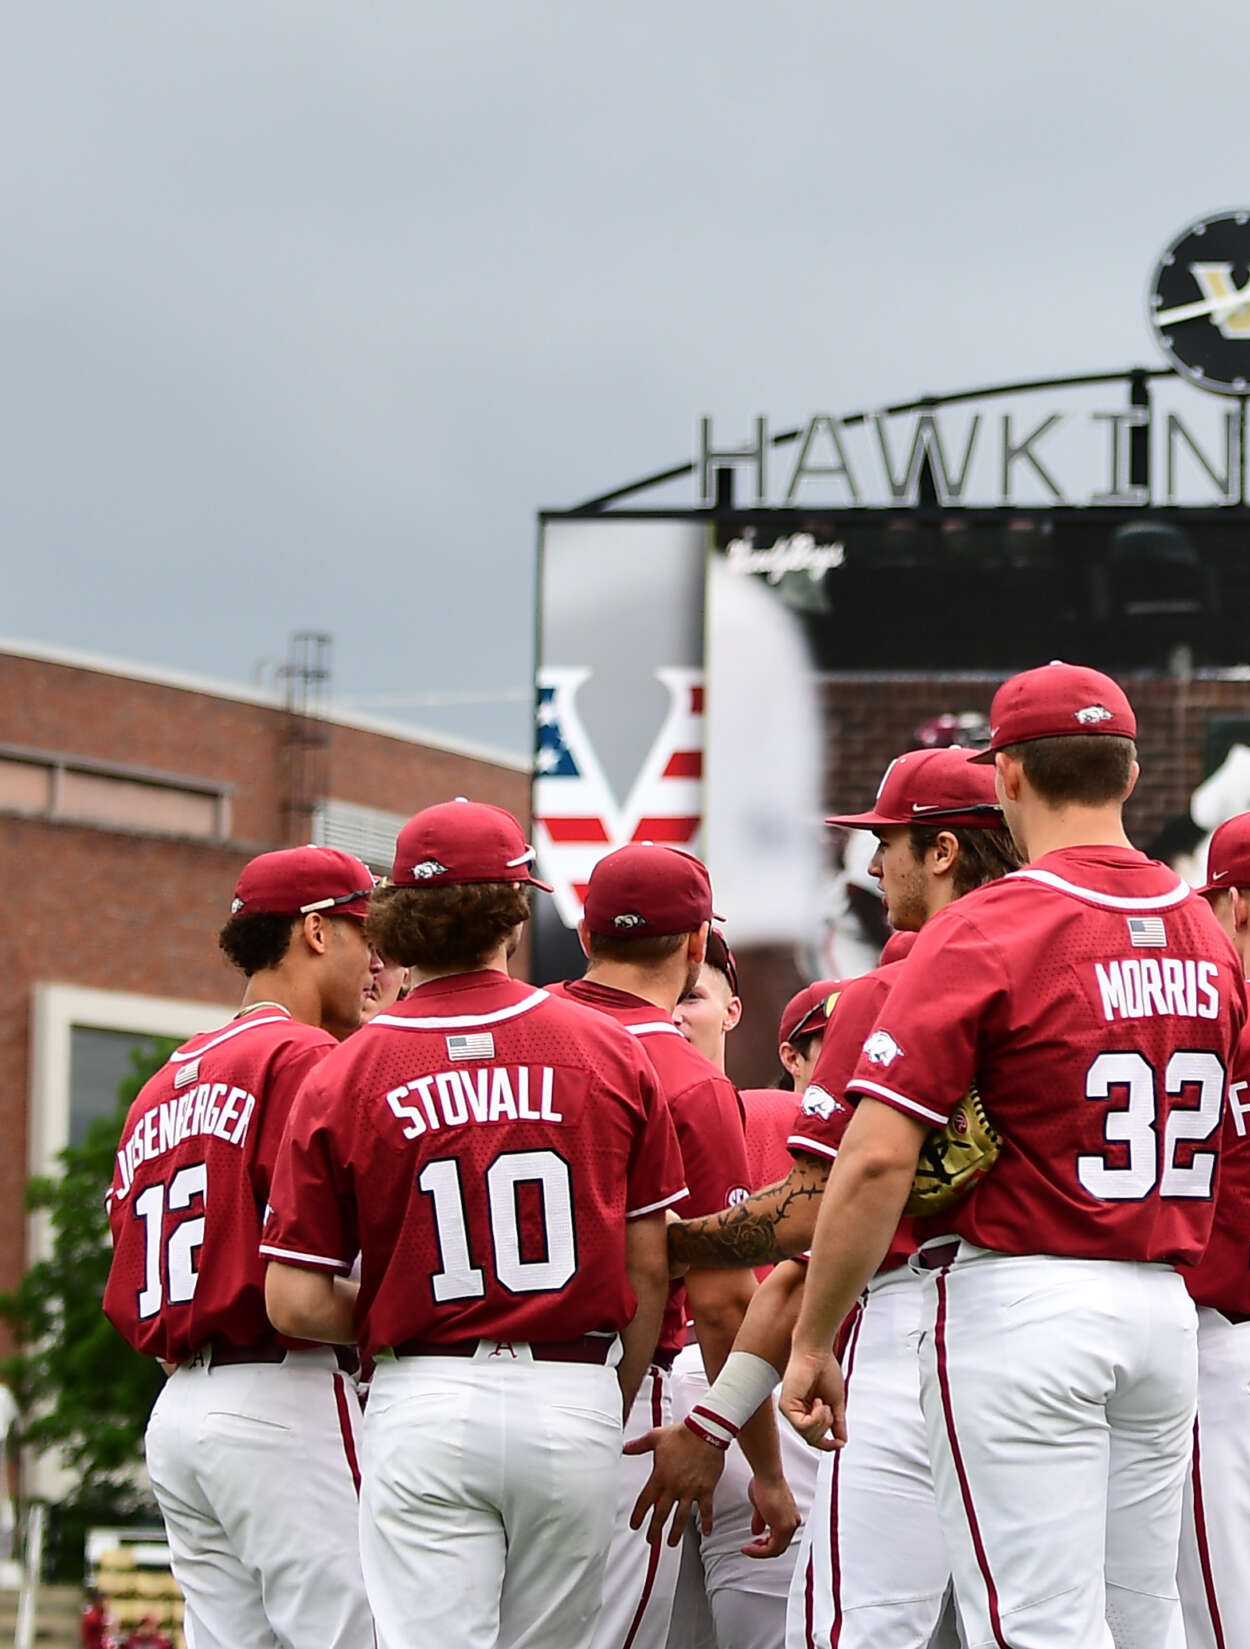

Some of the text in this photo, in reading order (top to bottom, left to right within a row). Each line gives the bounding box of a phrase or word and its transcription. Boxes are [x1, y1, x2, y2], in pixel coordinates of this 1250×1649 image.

[1094, 957, 1219, 1021] MORRIS
[386, 1066, 563, 1140] STOVALL
[1076, 1049, 1227, 1201] 32
[133, 1161, 208, 1321] 12
[418, 1149, 577, 1304] 10
